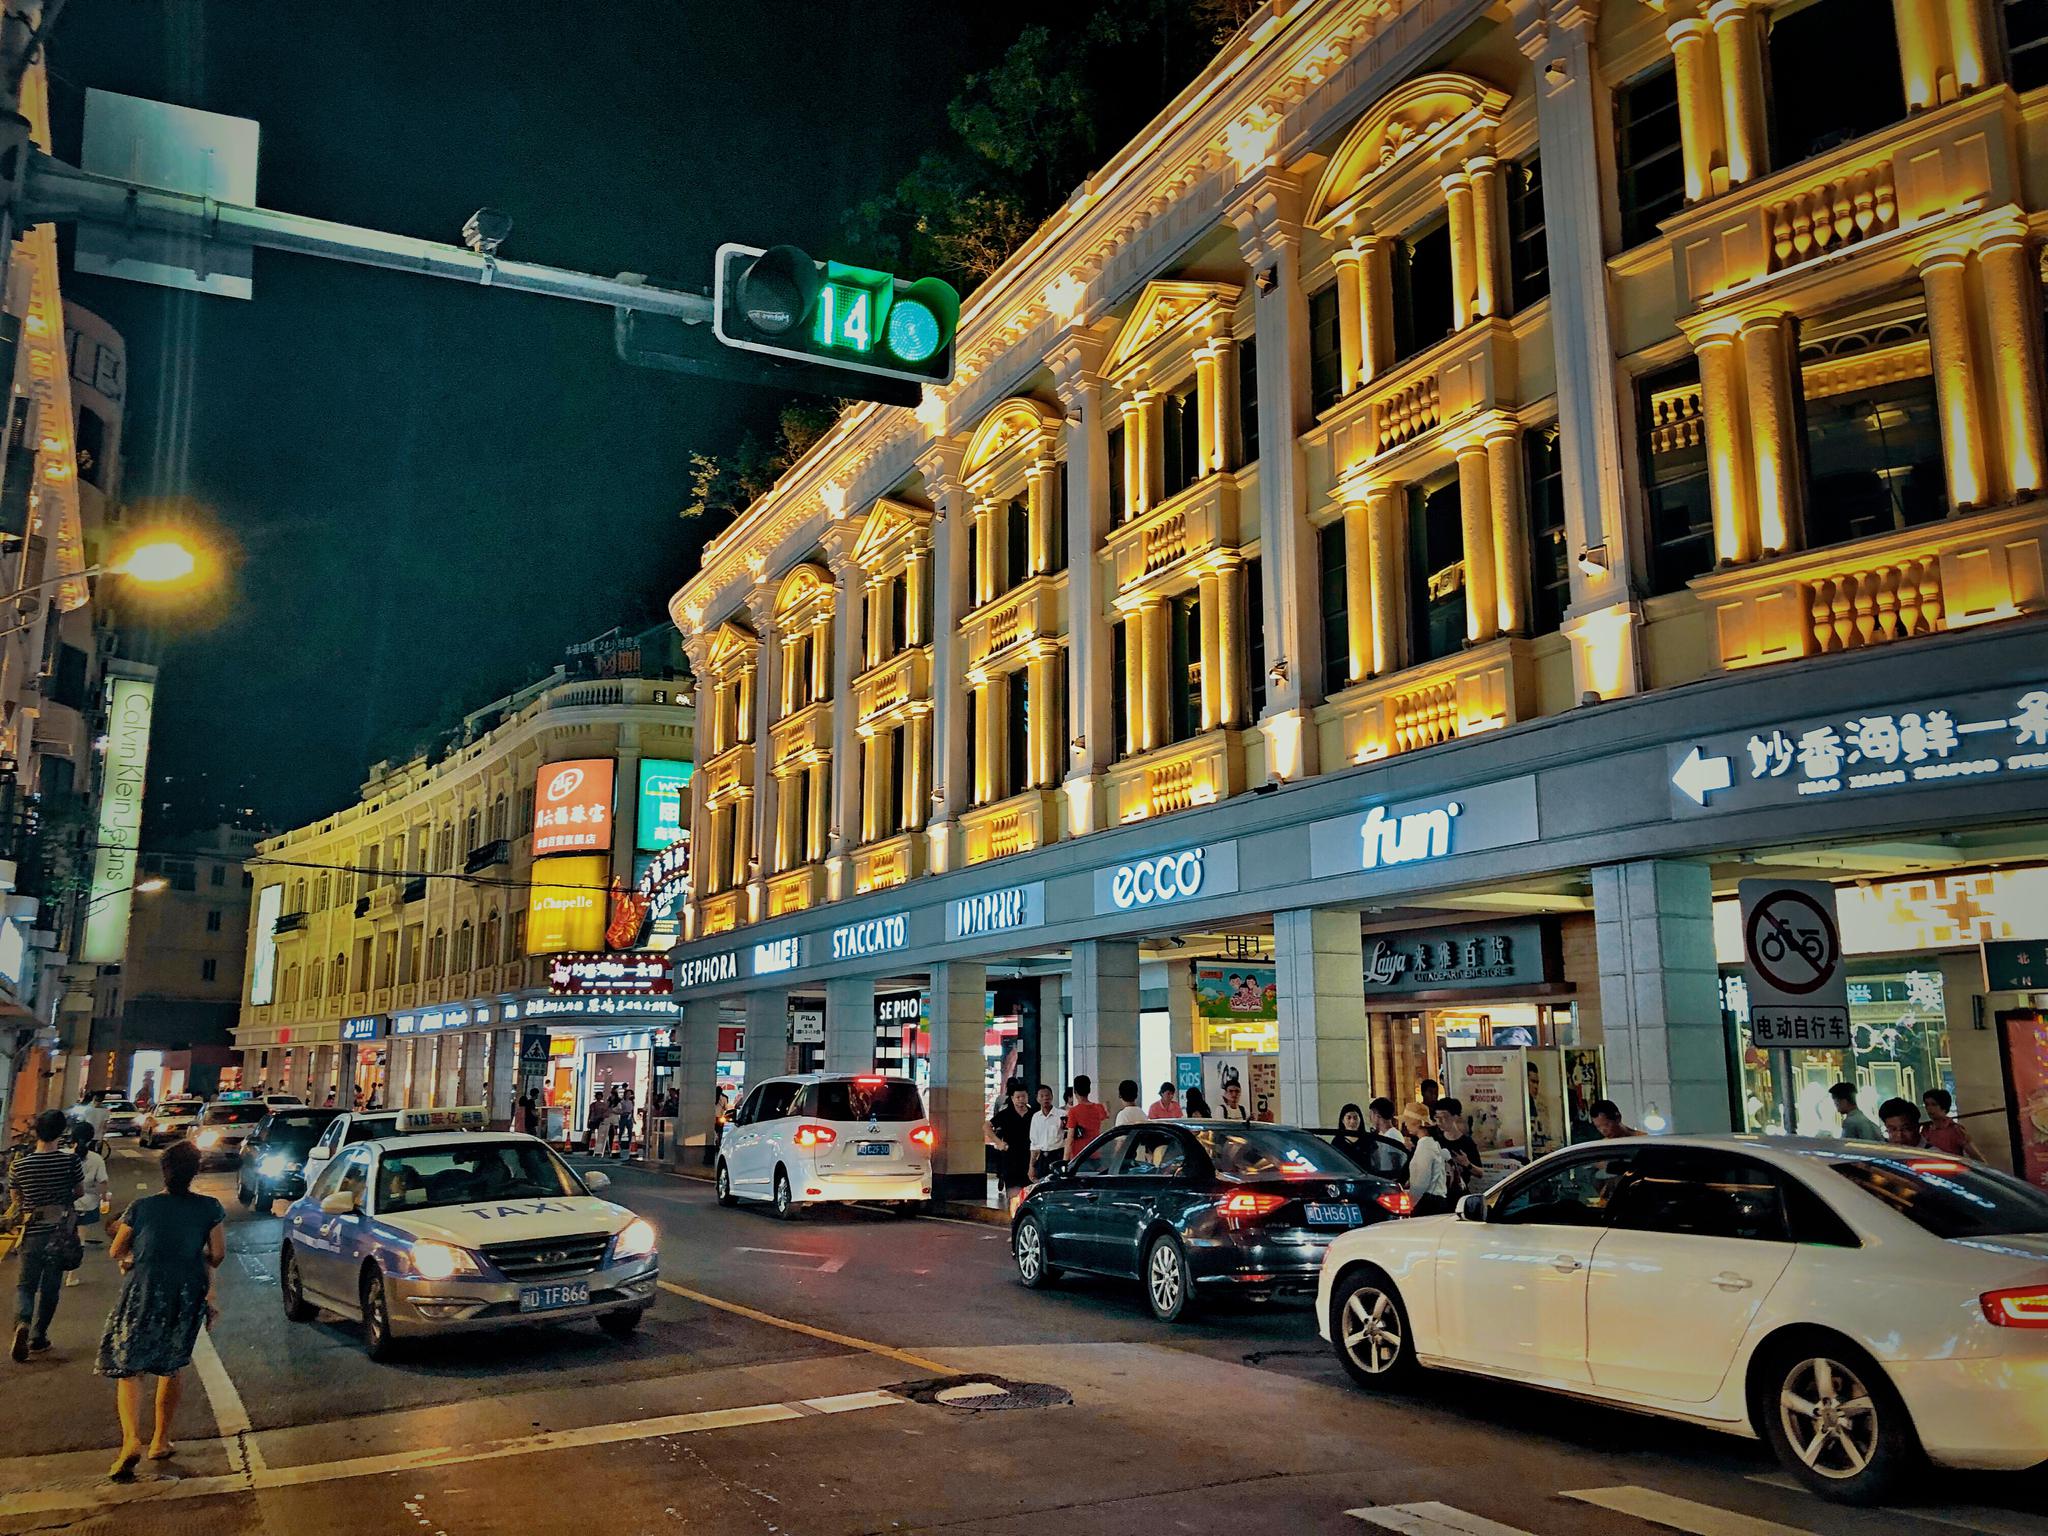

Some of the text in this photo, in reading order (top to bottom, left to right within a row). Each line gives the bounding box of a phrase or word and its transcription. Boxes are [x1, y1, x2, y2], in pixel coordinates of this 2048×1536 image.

[821, 286, 869, 350] 14
[106, 693, 150, 882] Calvin Klein Jeans
[1361, 804, 1460, 869] fun
[1112, 847, 1205, 909] ecco
[543, 896, 593, 911] Chapelle
[832, 915, 907, 959] STACCATO
[1413, 935, 1506, 971] 来雅百货
[680, 952, 738, 987] SEPHORA
[1363, 940, 1407, 986] Laiya
[1756, 1015, 1846, 1040] 电动自行车
[1179, 1071, 1201, 1087] KIDS
[462, 1202, 577, 1220] TAXI
